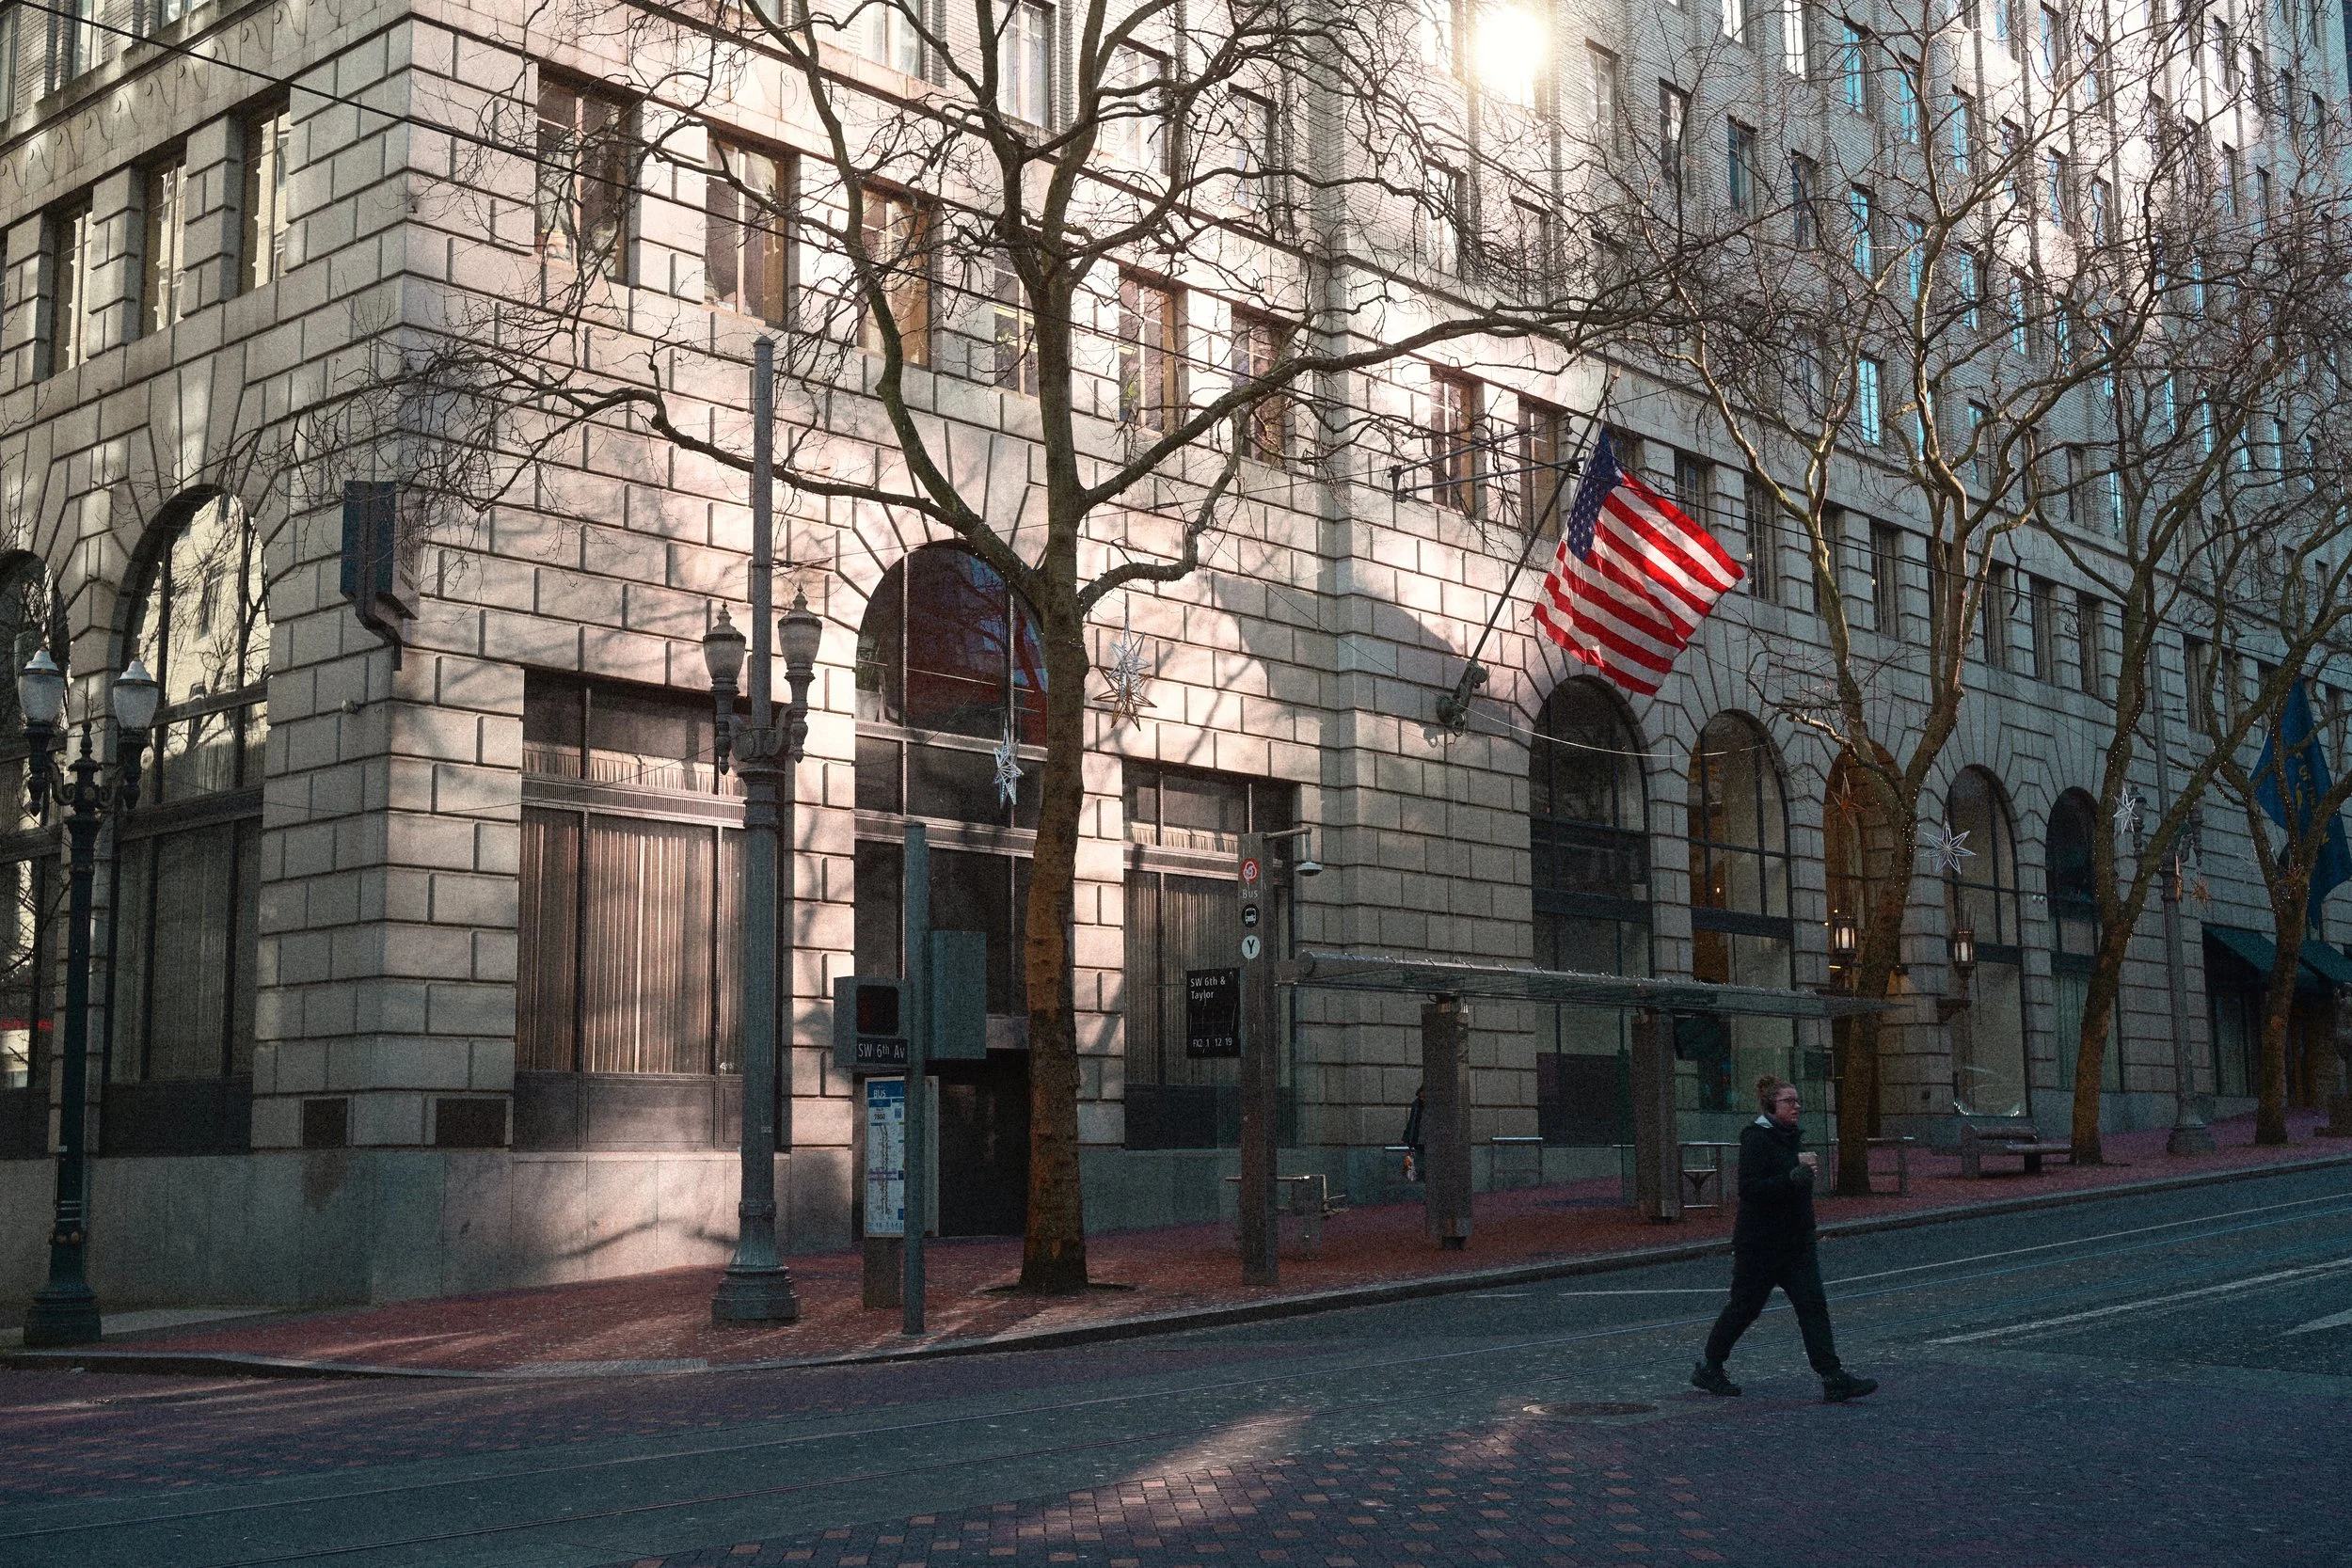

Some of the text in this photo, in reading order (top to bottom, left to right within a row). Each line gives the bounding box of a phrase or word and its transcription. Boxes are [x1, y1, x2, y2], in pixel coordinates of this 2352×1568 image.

[1242, 889, 1258, 899] Bus
[1247, 939, 1255, 954] Y
[1190, 975, 1226, 988] SW 6th &
[1190, 990, 1214, 1001] Taylor
[1205, 1038, 1210, 1048] 1
[1215, 1037, 1222, 1047] 12
[1225, 1037, 1232, 1046] 19
[858, 1043, 872, 1057] SW
[876, 1043, 889, 1058] 6th
[873, 1089, 886, 1099] BUS
